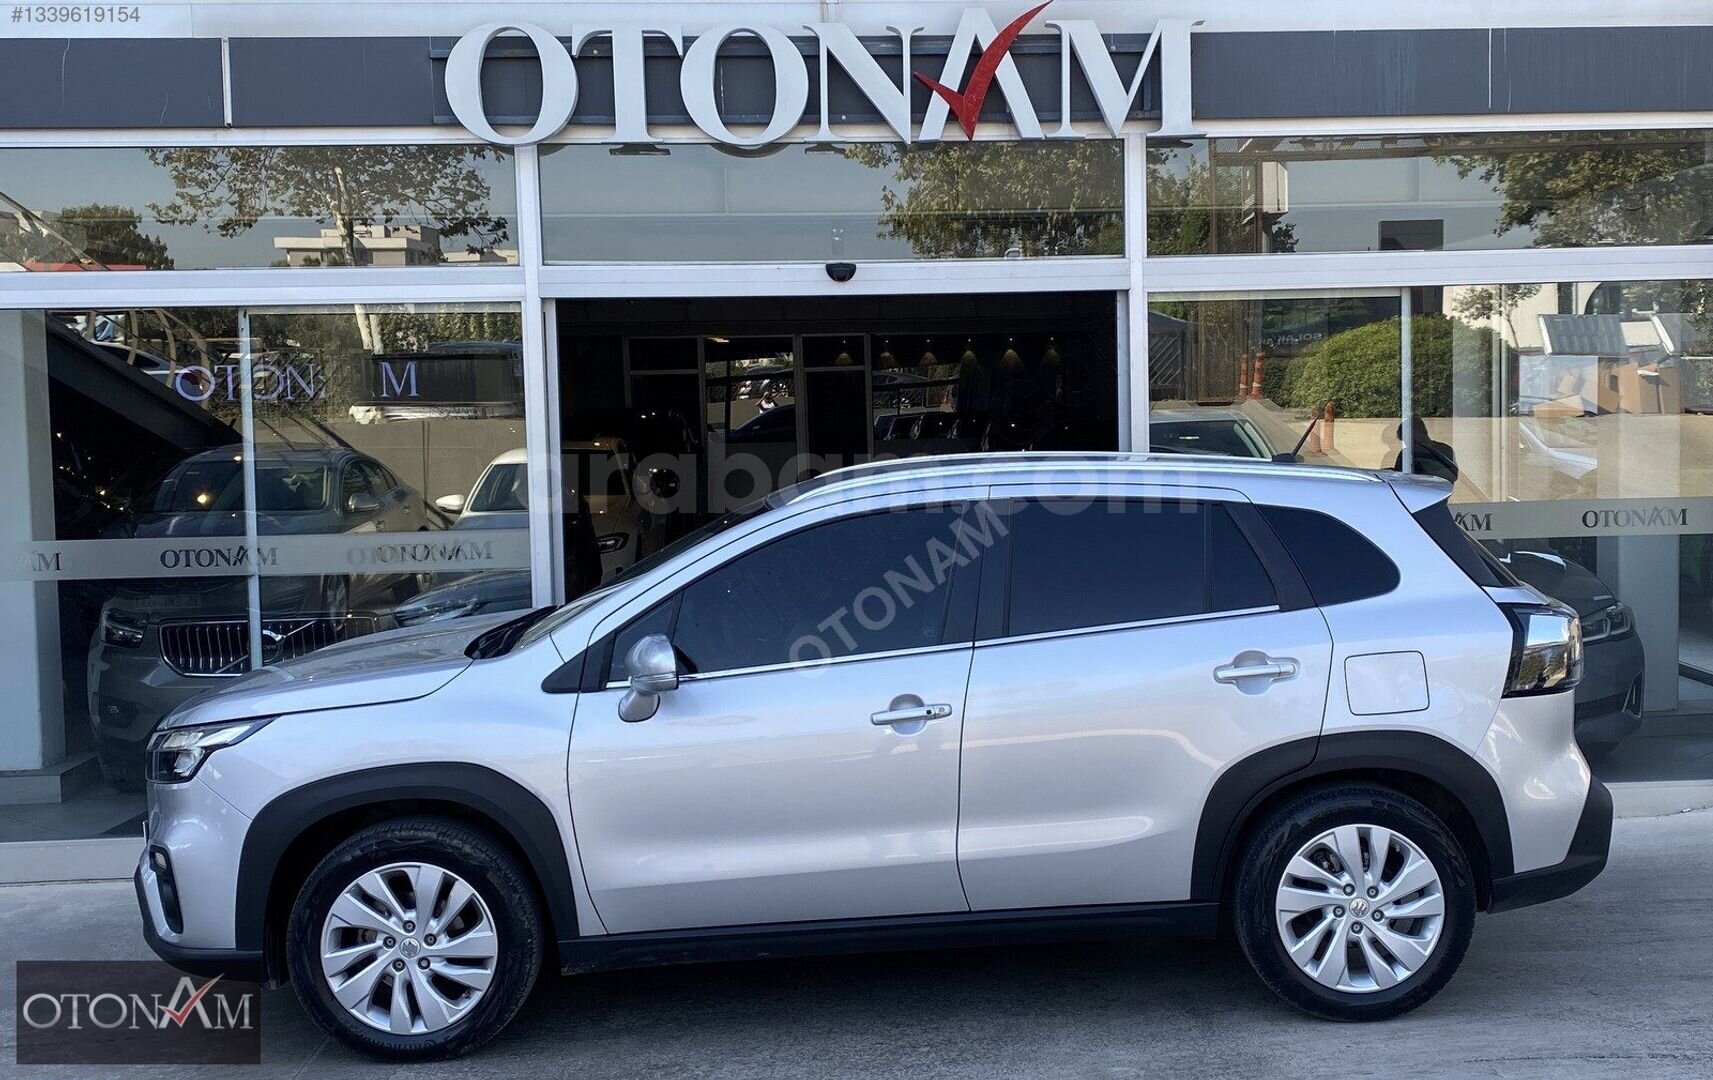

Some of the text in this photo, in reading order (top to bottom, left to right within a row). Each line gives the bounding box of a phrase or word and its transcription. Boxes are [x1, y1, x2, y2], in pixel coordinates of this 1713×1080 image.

[444, 5, 1208, 147] OTONAM
[1581, 506, 1689, 529] OTONAM
[159, 544, 279, 569] OTONAM
